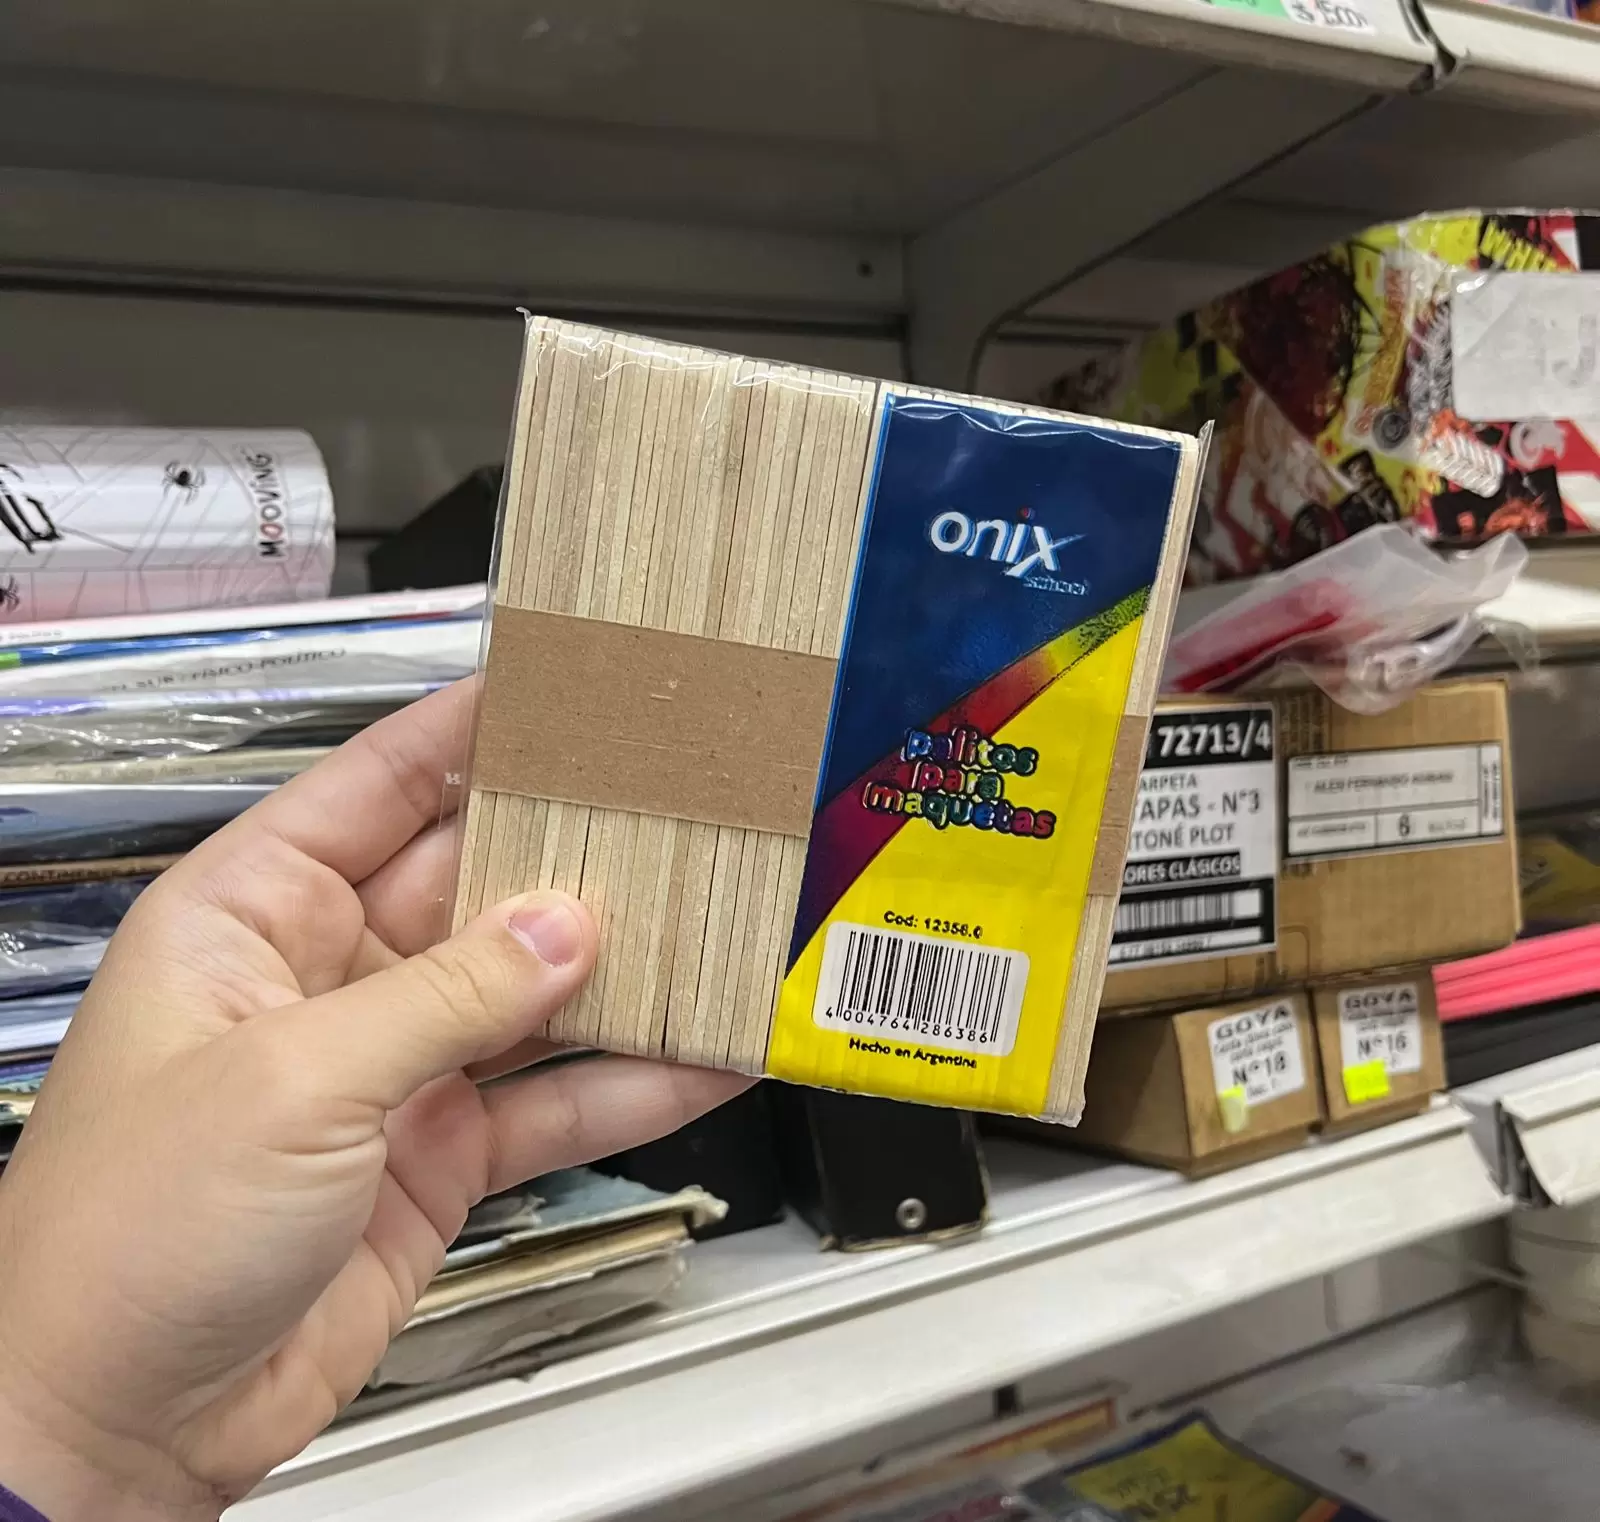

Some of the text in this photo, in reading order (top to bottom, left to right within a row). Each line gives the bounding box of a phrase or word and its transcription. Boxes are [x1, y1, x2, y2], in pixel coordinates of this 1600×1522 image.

[929, 506, 1087, 578] onix
[1157, 717, 1272, 758] 72713/4
[1140, 771, 1199, 793] ARPETA
[862, 781, 1057, 840] maquetas
[1138, 793, 1201, 822] APAS
[1131, 822, 1237, 851] TONÉ PLOT
[1124, 863, 1166, 886] ORES
[883, 910, 919, 929] Cod:
[1345, 986, 1414, 1010] GOYA
[1216, 1005, 1290, 1040] GOYA
[848, 1036, 978, 1069] Hecho en Argentina
